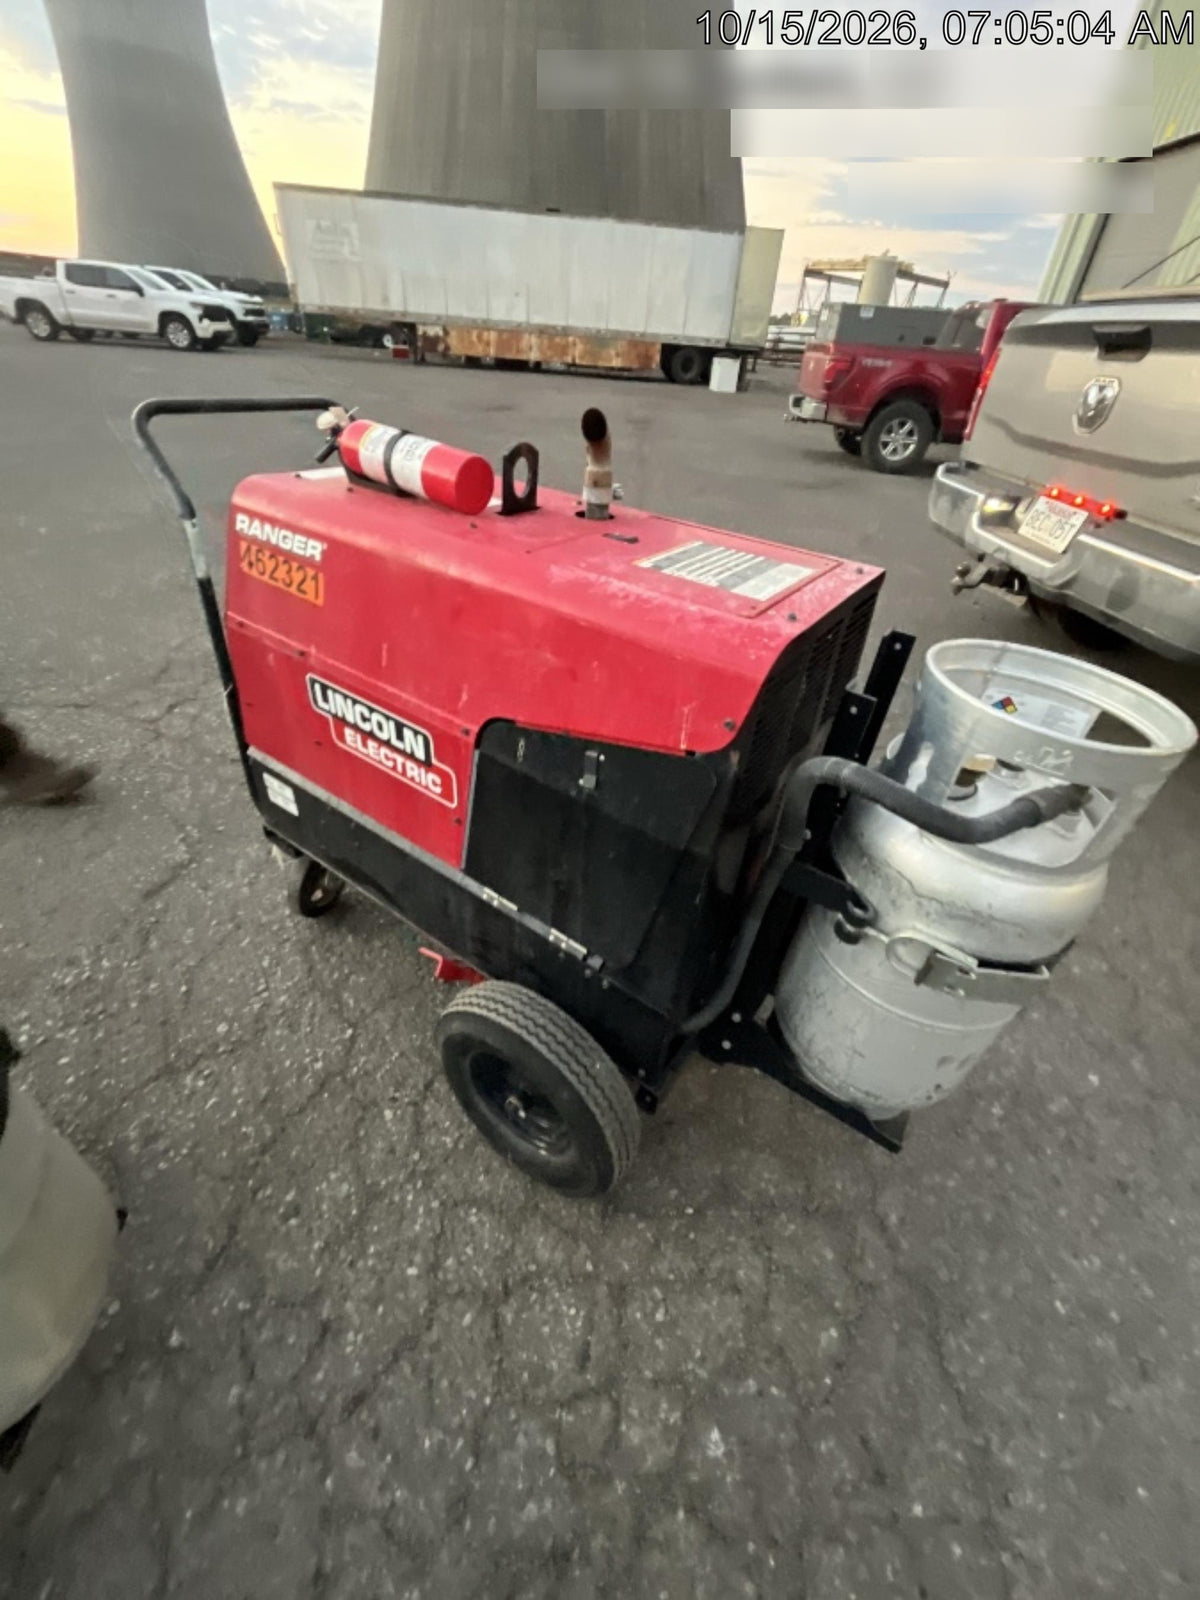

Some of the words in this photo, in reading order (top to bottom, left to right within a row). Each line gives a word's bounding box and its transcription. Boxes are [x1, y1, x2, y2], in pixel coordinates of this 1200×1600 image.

[235, 512, 323, 563] RANGER
[242, 544, 320, 601] 462321
[314, 682, 428, 761] LINCOLN
[343, 729, 443, 794] ELECTRIC
